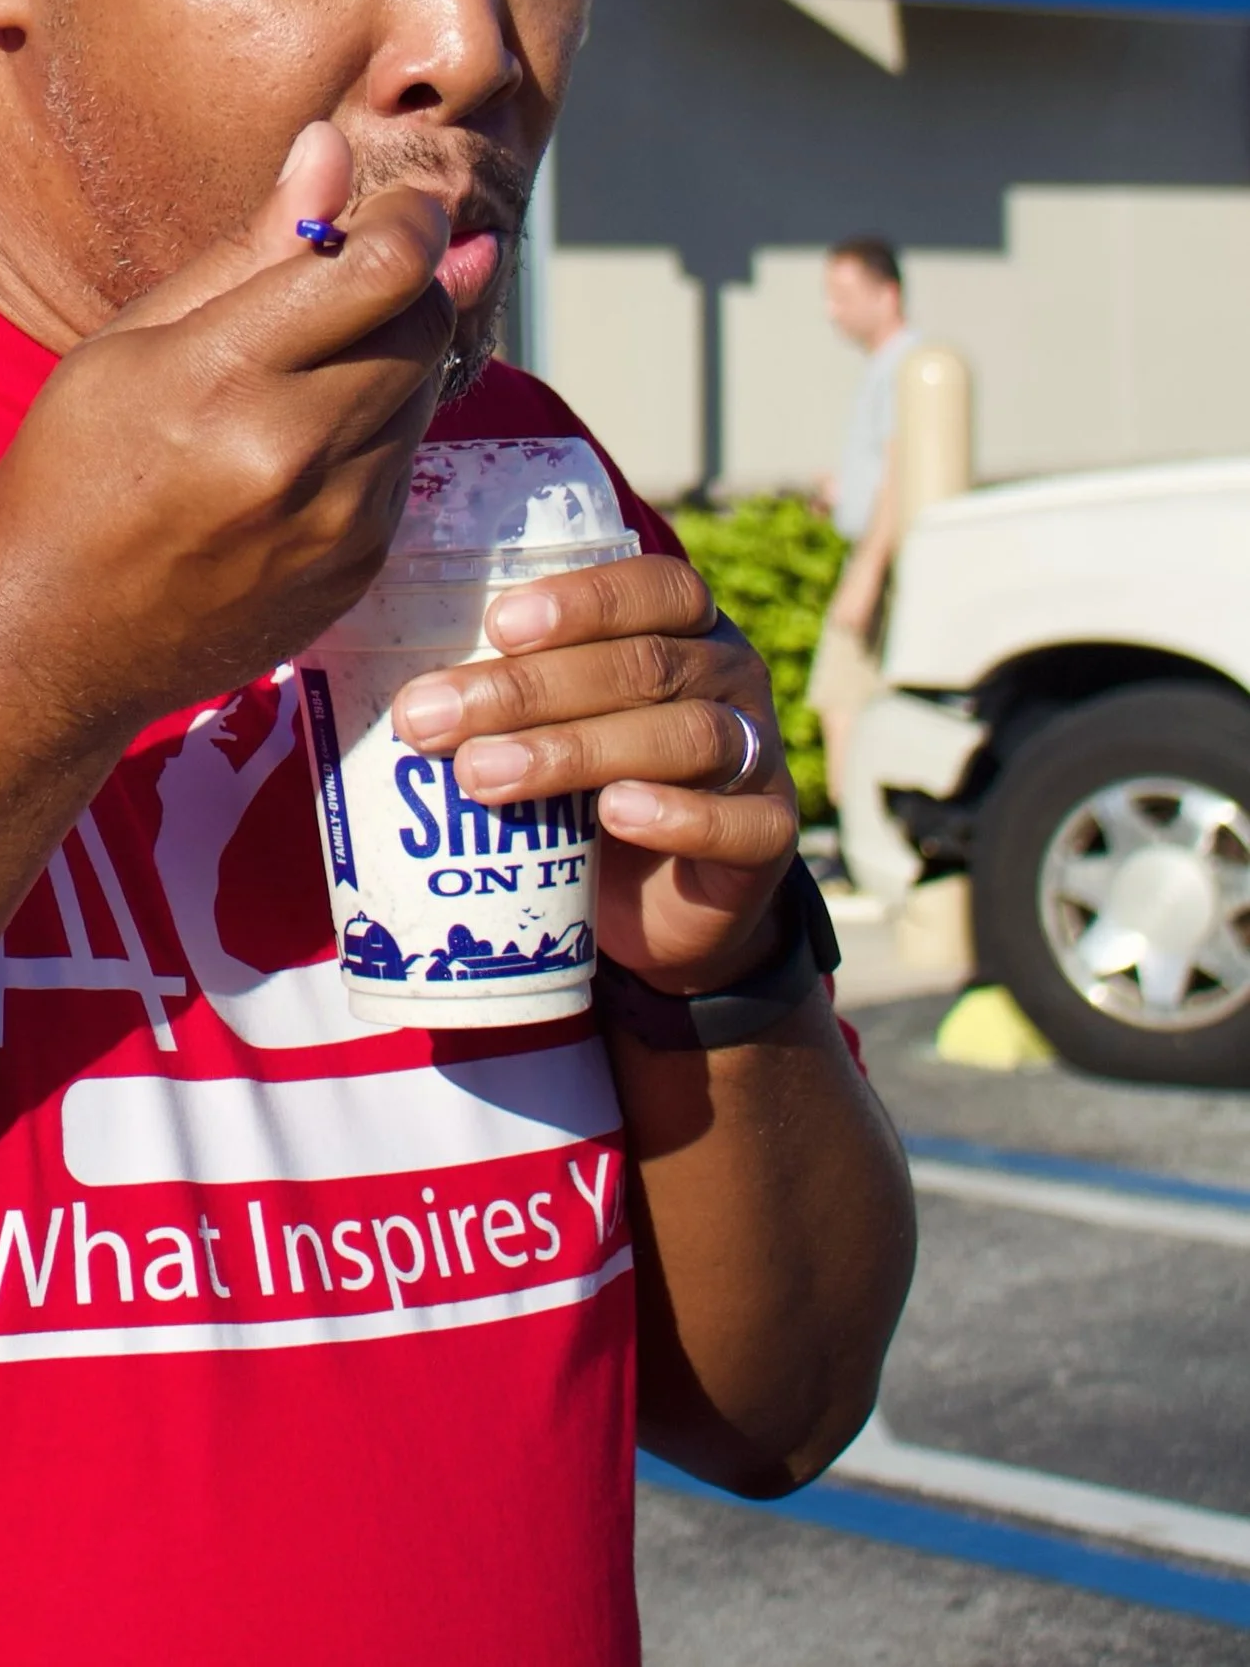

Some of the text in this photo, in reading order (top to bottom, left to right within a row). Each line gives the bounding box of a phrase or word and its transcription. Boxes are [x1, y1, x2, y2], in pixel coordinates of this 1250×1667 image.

[310, 689, 327, 720] 1984
[323, 763, 347, 865] FAMILY-OWNED
[427, 854, 586, 897] ON IT
[247, 1187, 561, 1310] Inspires
